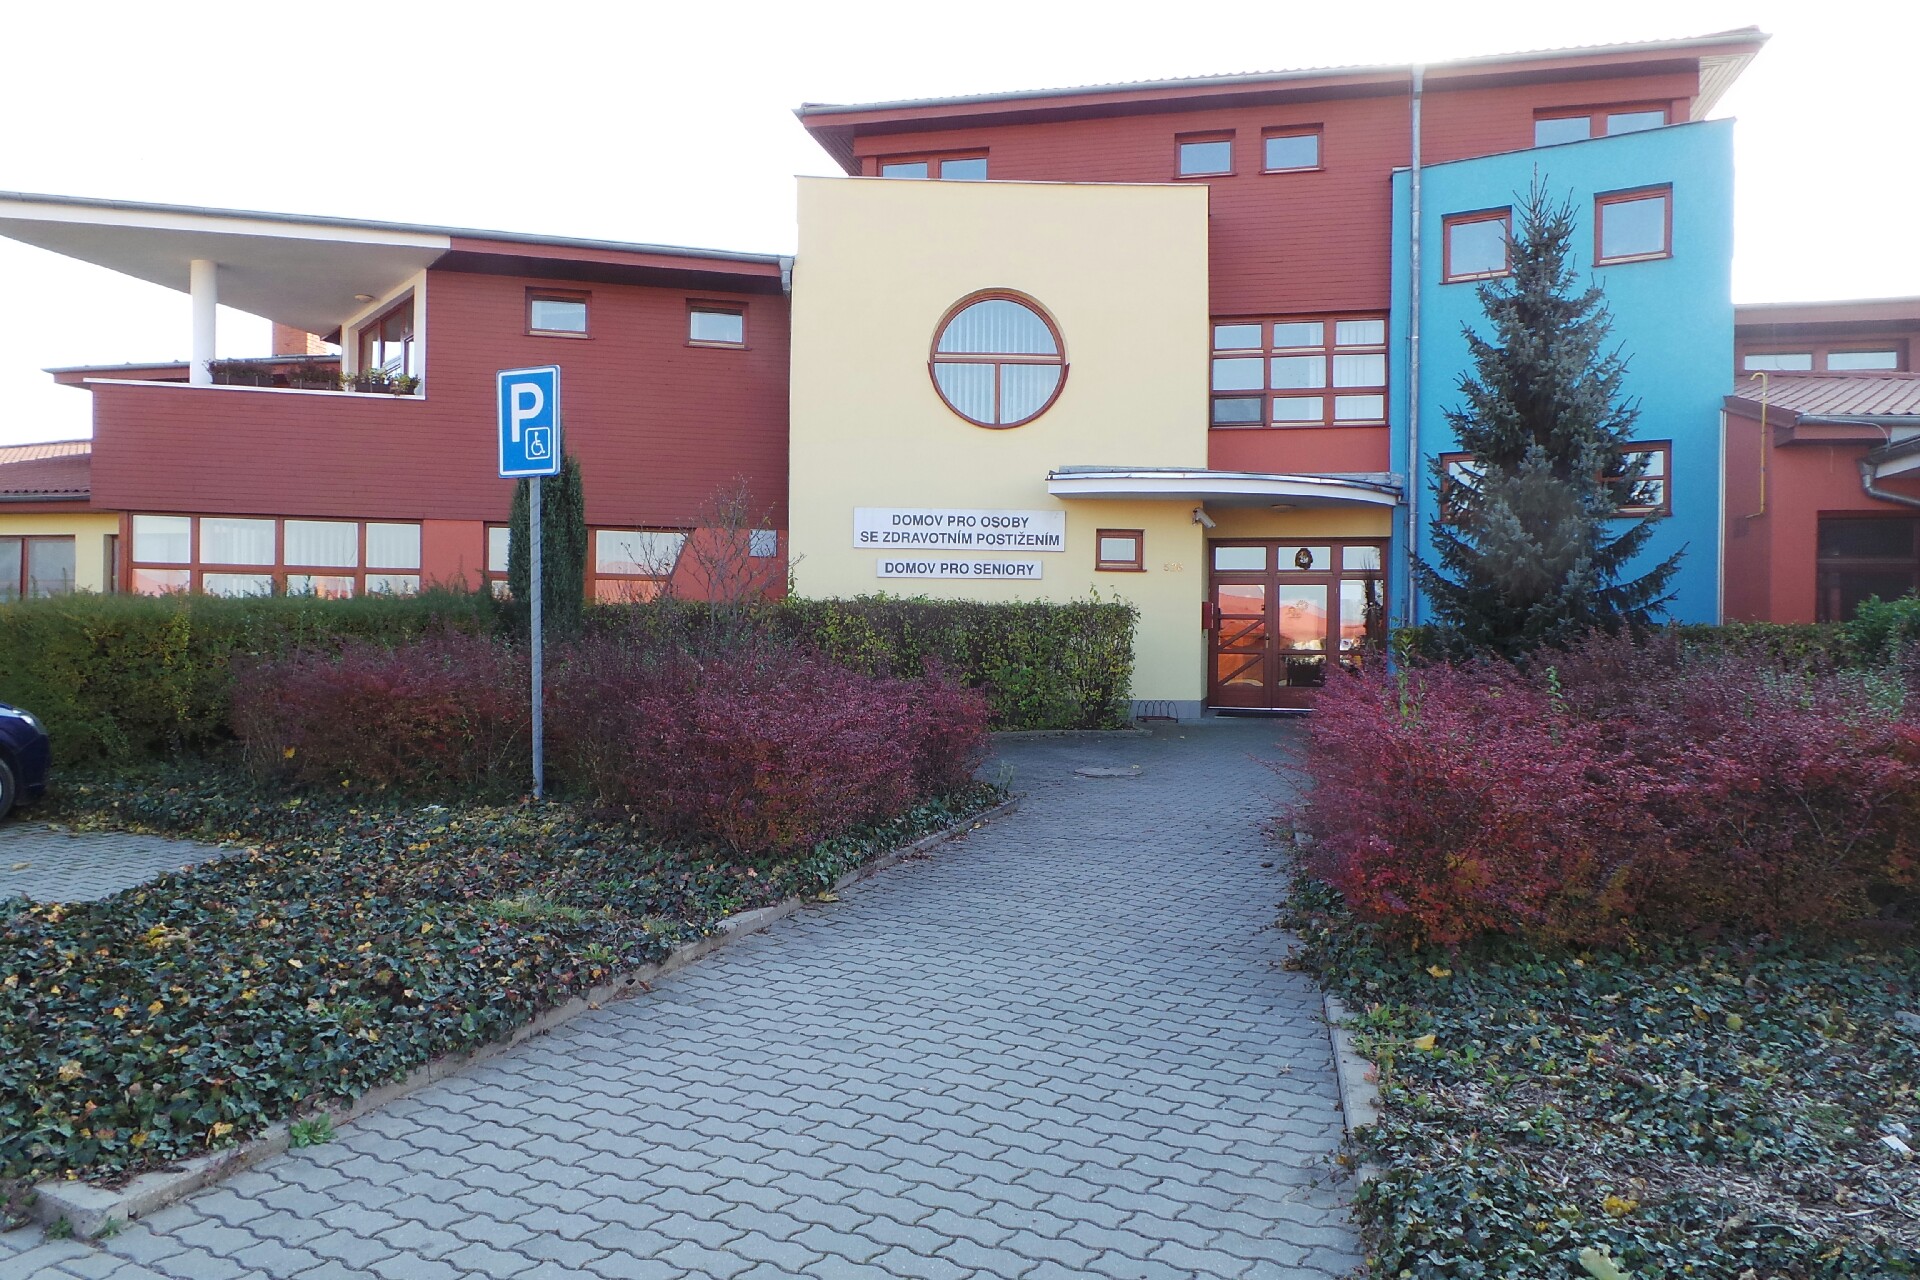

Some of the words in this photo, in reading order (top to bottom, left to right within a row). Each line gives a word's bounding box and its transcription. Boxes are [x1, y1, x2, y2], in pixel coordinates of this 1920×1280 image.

[511, 383, 544, 443] P
[892, 514, 943, 527] DOMOV
[947, 515, 976, 528] PRO
[980, 516, 1029, 529] OSOBY
[860, 531, 879, 543] SE
[882, 530, 972, 545] ZDRAVOTNÍM
[976, 531, 1060, 546] POSTIŽENÍM
[885, 562, 936, 574] DOMOV
[940, 563, 970, 575] PRO
[973, 563, 1035, 576] SENIORY
